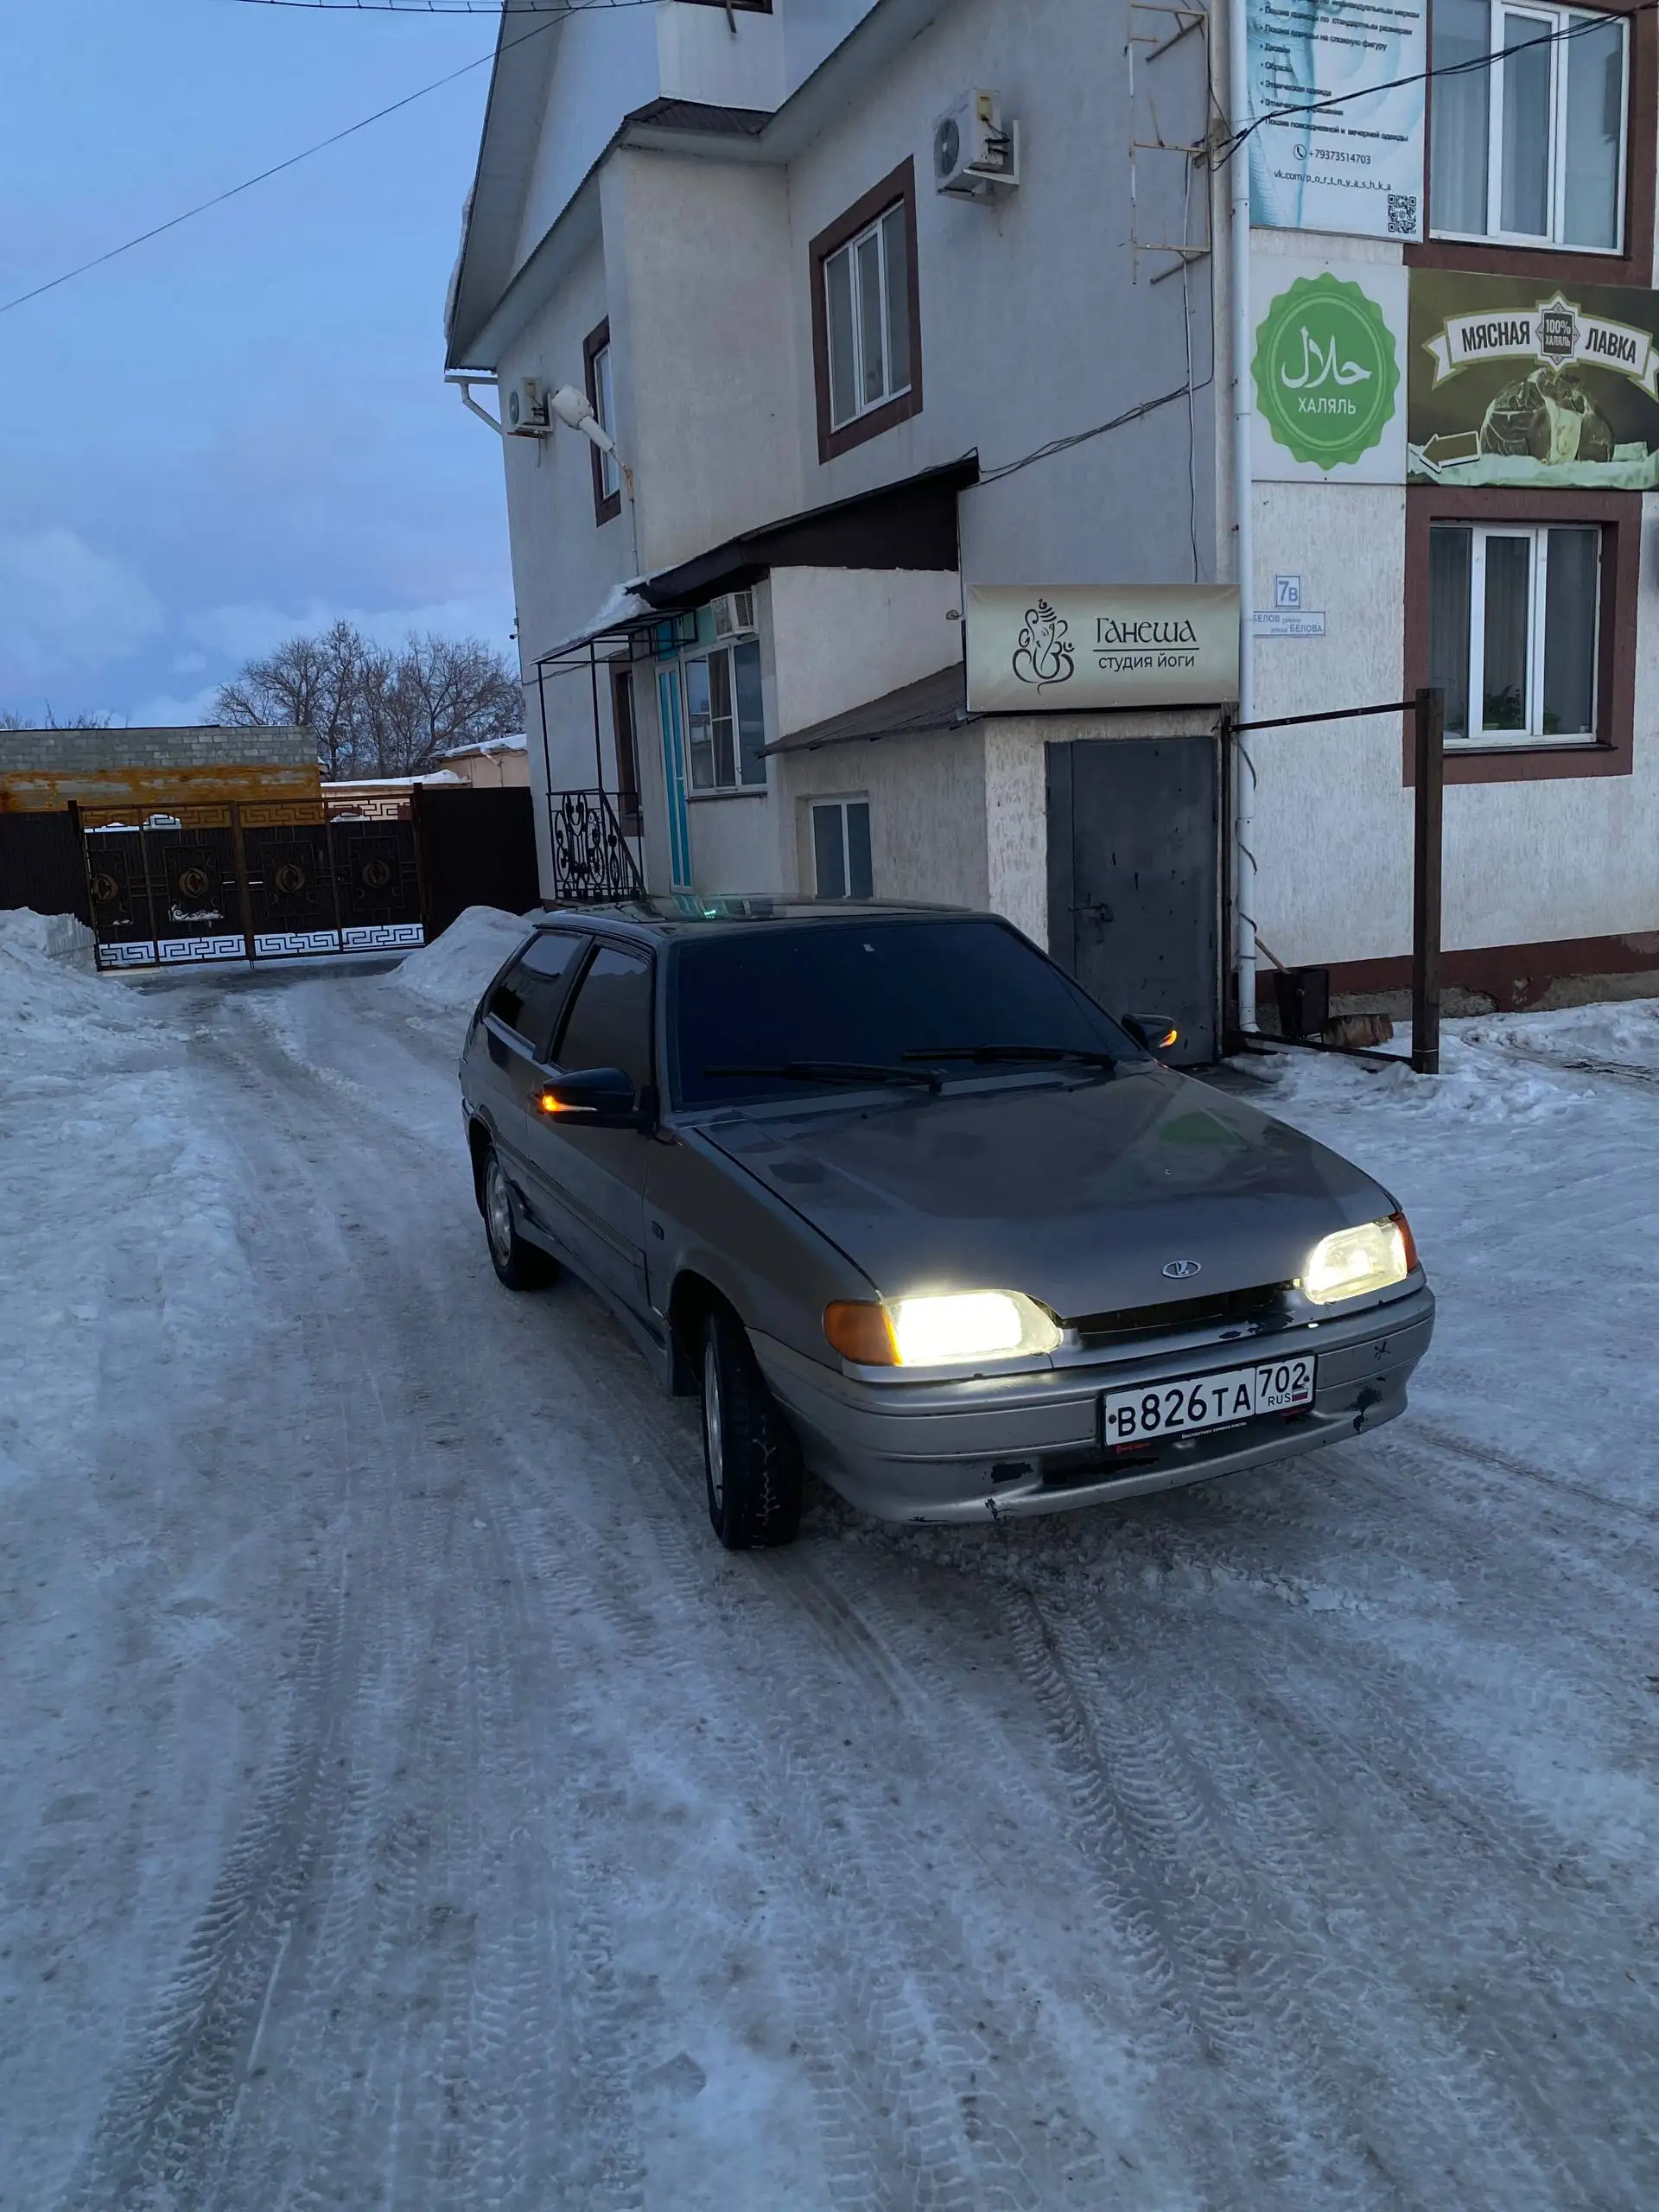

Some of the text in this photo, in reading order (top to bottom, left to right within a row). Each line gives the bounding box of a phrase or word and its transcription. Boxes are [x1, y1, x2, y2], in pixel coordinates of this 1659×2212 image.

[1362, 40, 1388, 52] фигуру
[1309, 149, 1371, 165] +79373514703
[1545, 319, 1572, 334] 100%
[1461, 321, 1637, 364] МЯСНАЯ ЛАВКА
[1281, 325, 1372, 389] حلال
[1298, 397, 1357, 416] ХАЛЯЛЬ
[1289, 624, 1323, 632] БЕЛОВА
[1098, 652, 1195, 672] студия йоги
[1258, 1362, 1307, 1398] 702
[1268, 1392, 1292, 1407] RUS
